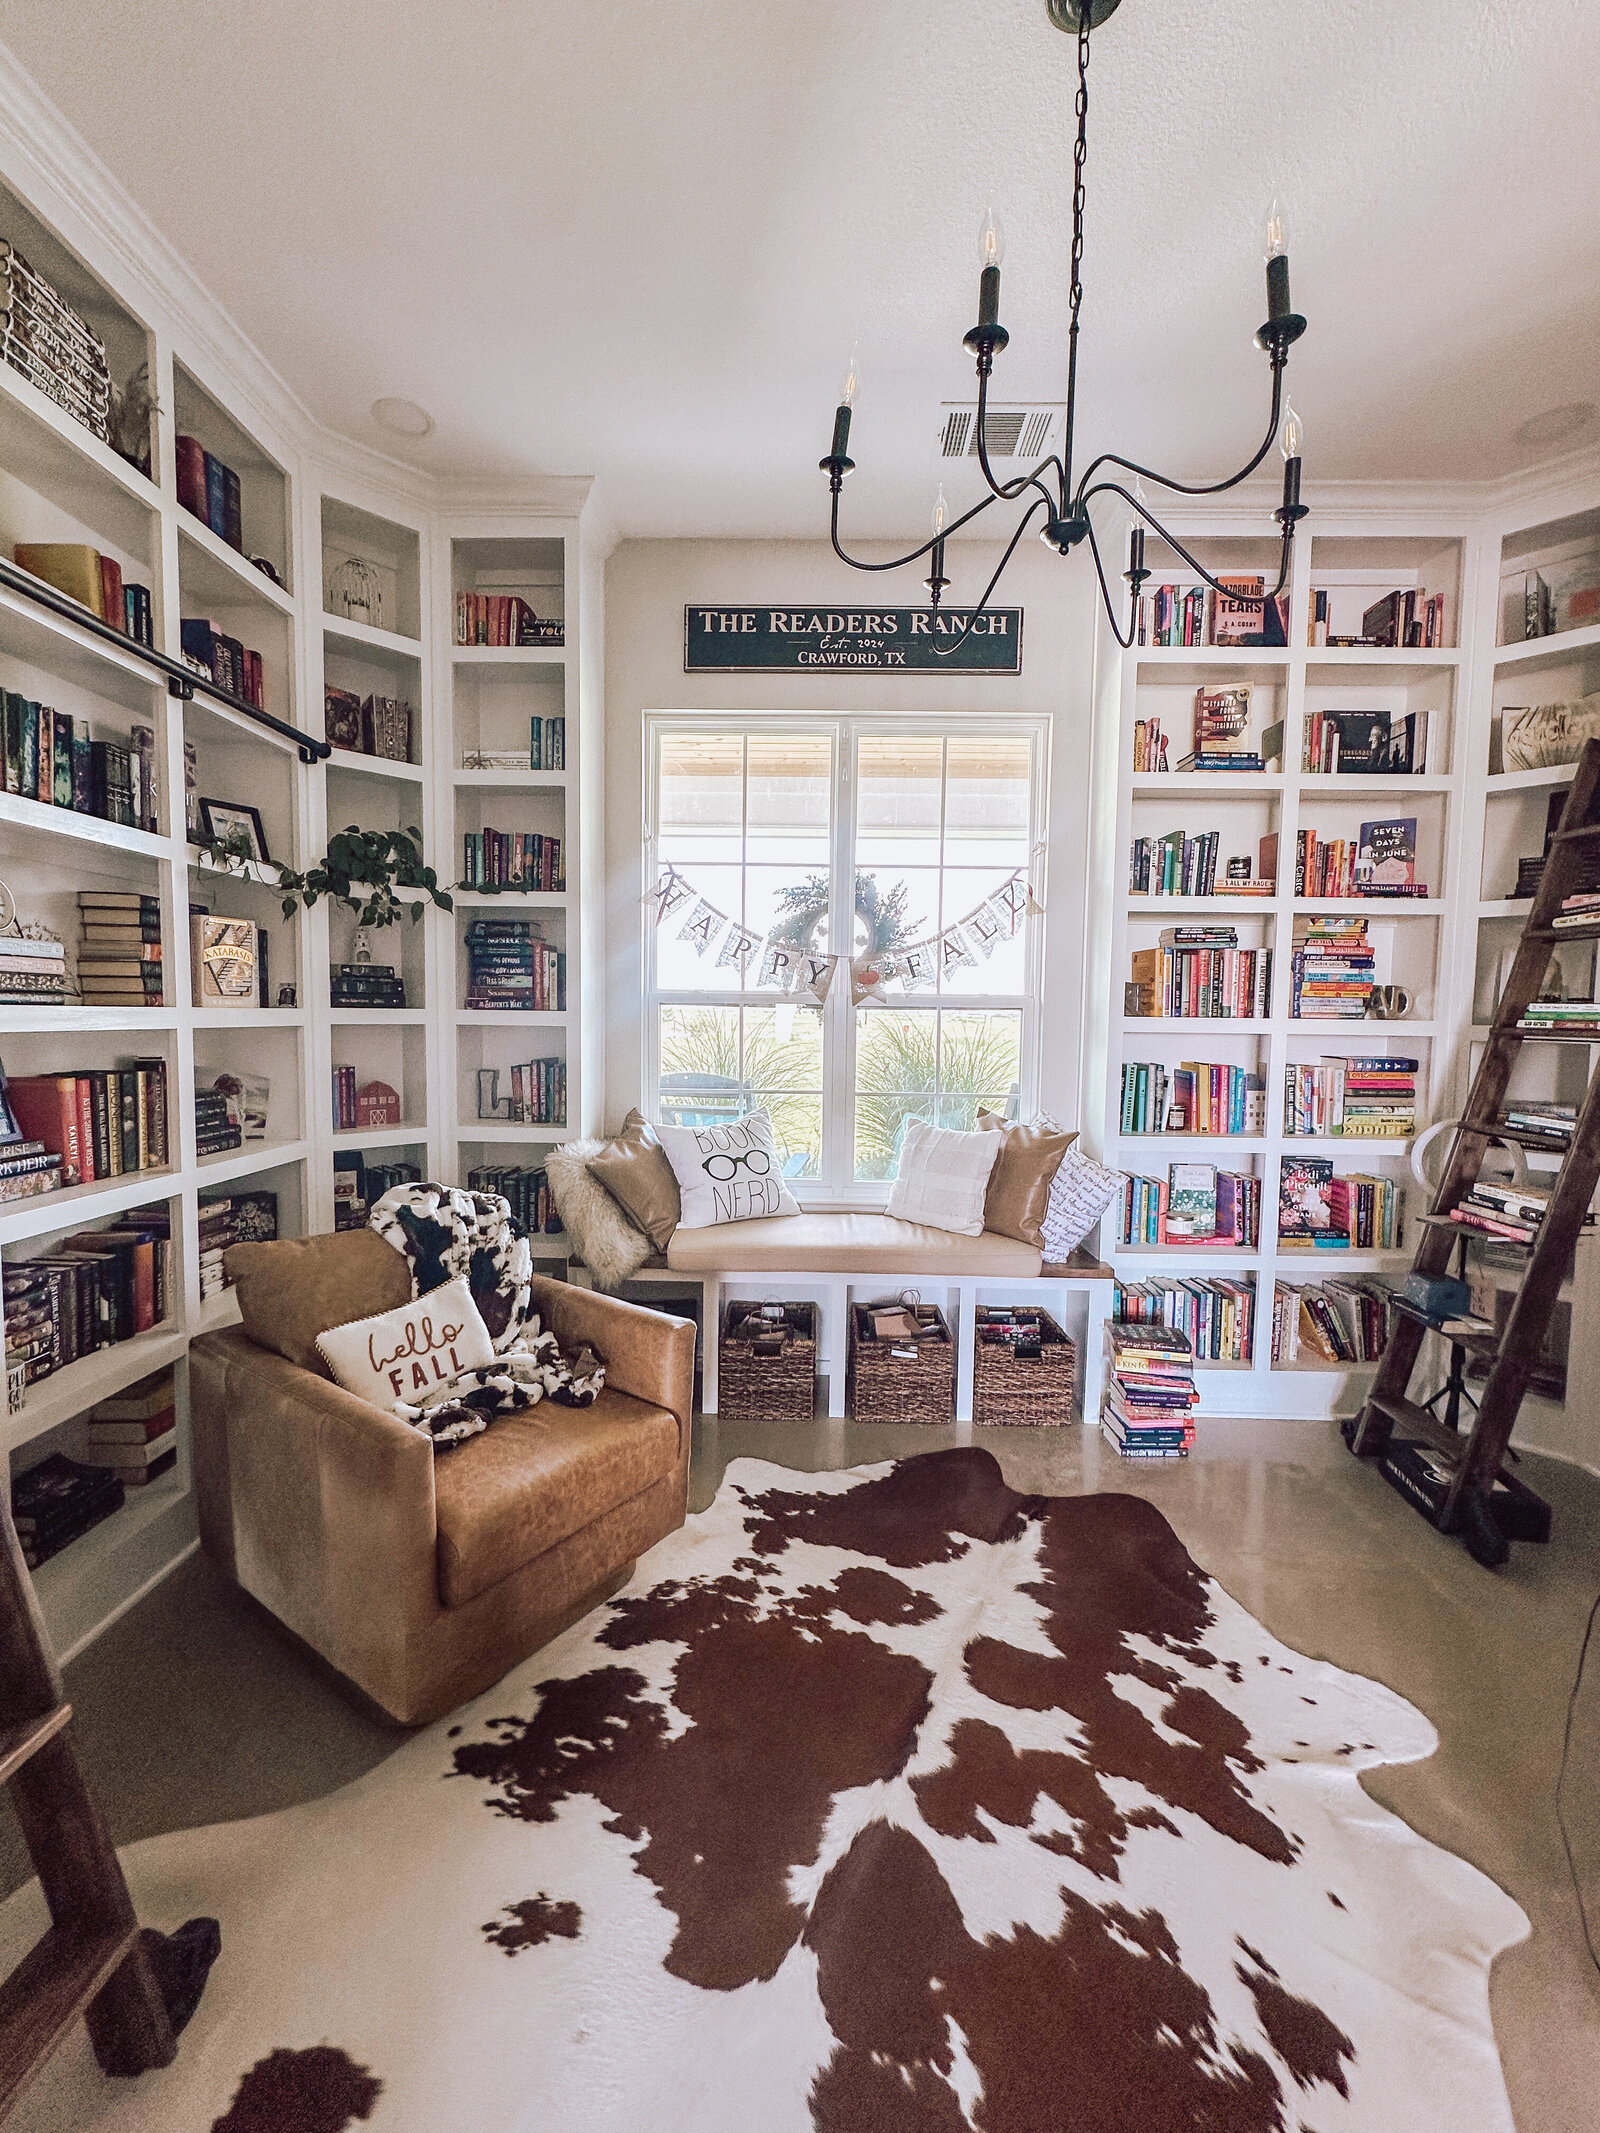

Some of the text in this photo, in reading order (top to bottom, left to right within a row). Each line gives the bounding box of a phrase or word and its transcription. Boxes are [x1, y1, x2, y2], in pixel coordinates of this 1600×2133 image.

[1219, 599, 1262, 614] TEARS
[699, 611, 1008, 635] THE READERS RANCH
[820, 635, 885, 649] Est. 2024
[797, 651, 907, 666] CRAWFORD, TX
[1373, 826, 1405, 836] SEVEN
[1375, 838, 1400, 847] DAYS
[1368, 851, 1379, 859] IN
[1382, 849, 1407, 858] JUNE
[1296, 865, 1305, 892] Caste
[654, 876, 831, 986] HAPPY
[904, 884, 1027, 979] FALL
[83, 1097, 90, 1106] AS
[83, 1107, 92, 1120] THE
[84, 1121, 93, 1147] SHADOW
[692, 1119, 766, 1155] BOOK
[68, 1124, 78, 1160] KAIKEYI
[2, 1143, 30, 1157] RISE
[16, 1155, 48, 1172] HEIR
[1297, 1169, 1320, 1180] Jodi
[1284, 1179, 1328, 1191] Picoult
[712, 1178, 781, 1222] NERD
[368, 1316, 465, 1373] hello
[1122, 1360, 1137, 1368] KEN
[388, 1347, 466, 1397] FALL
